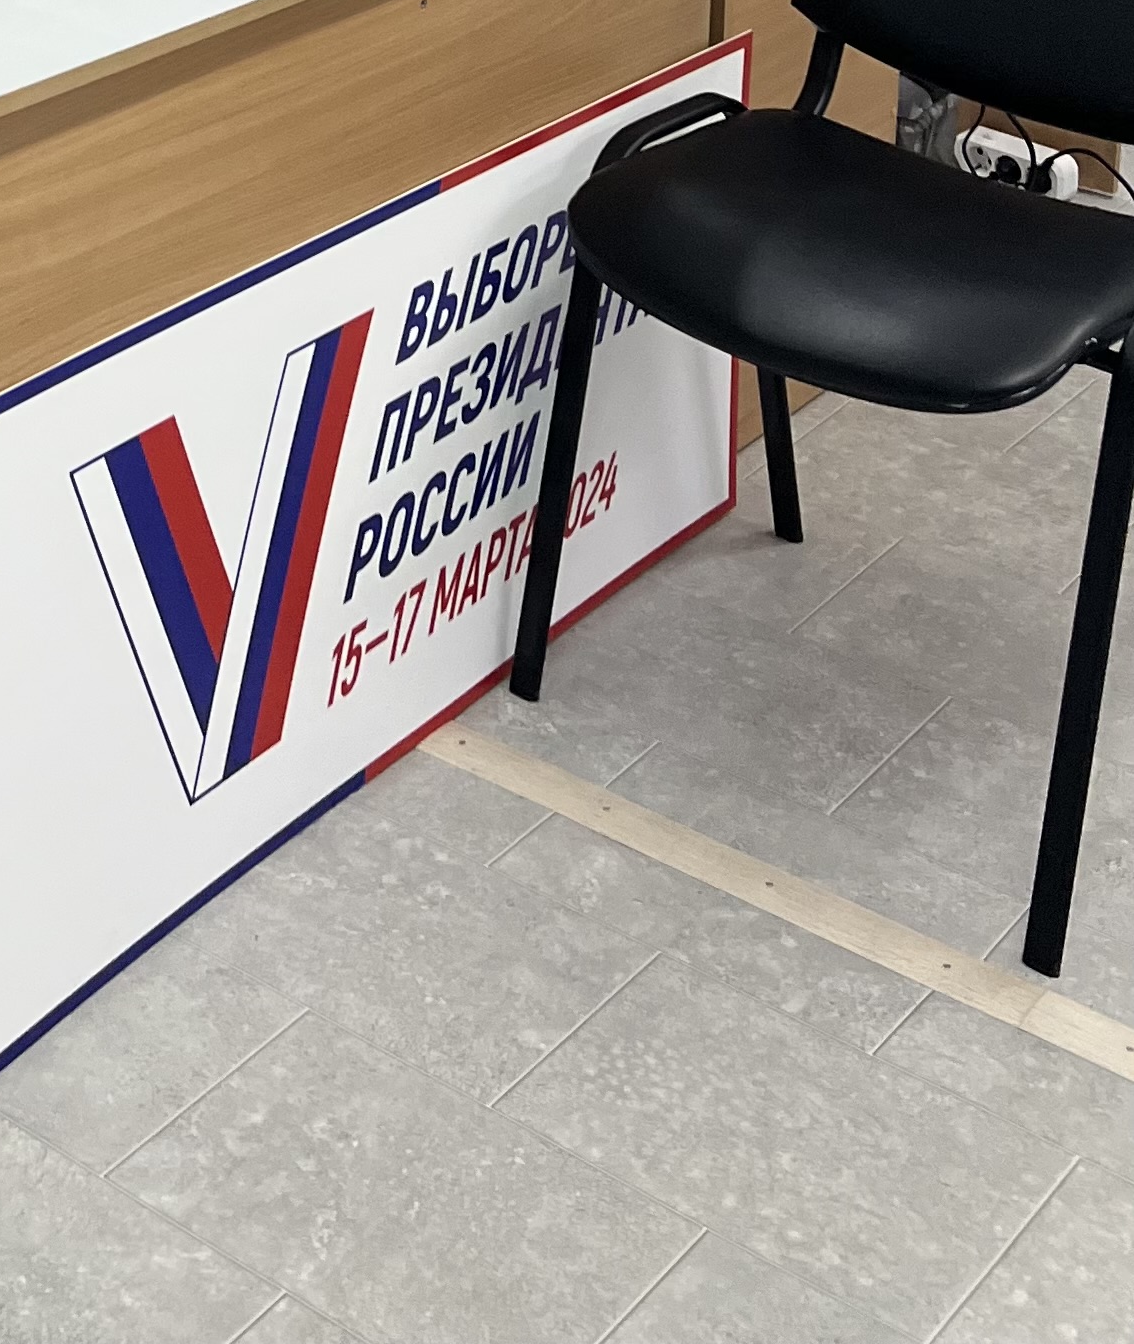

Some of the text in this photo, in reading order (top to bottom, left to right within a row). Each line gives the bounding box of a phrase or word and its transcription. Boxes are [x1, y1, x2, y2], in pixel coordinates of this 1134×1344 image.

[368, 287, 649, 485] ПРЕЗИДН
[343, 409, 541, 604] РОССИИ
[563, 450, 618, 540] 024
